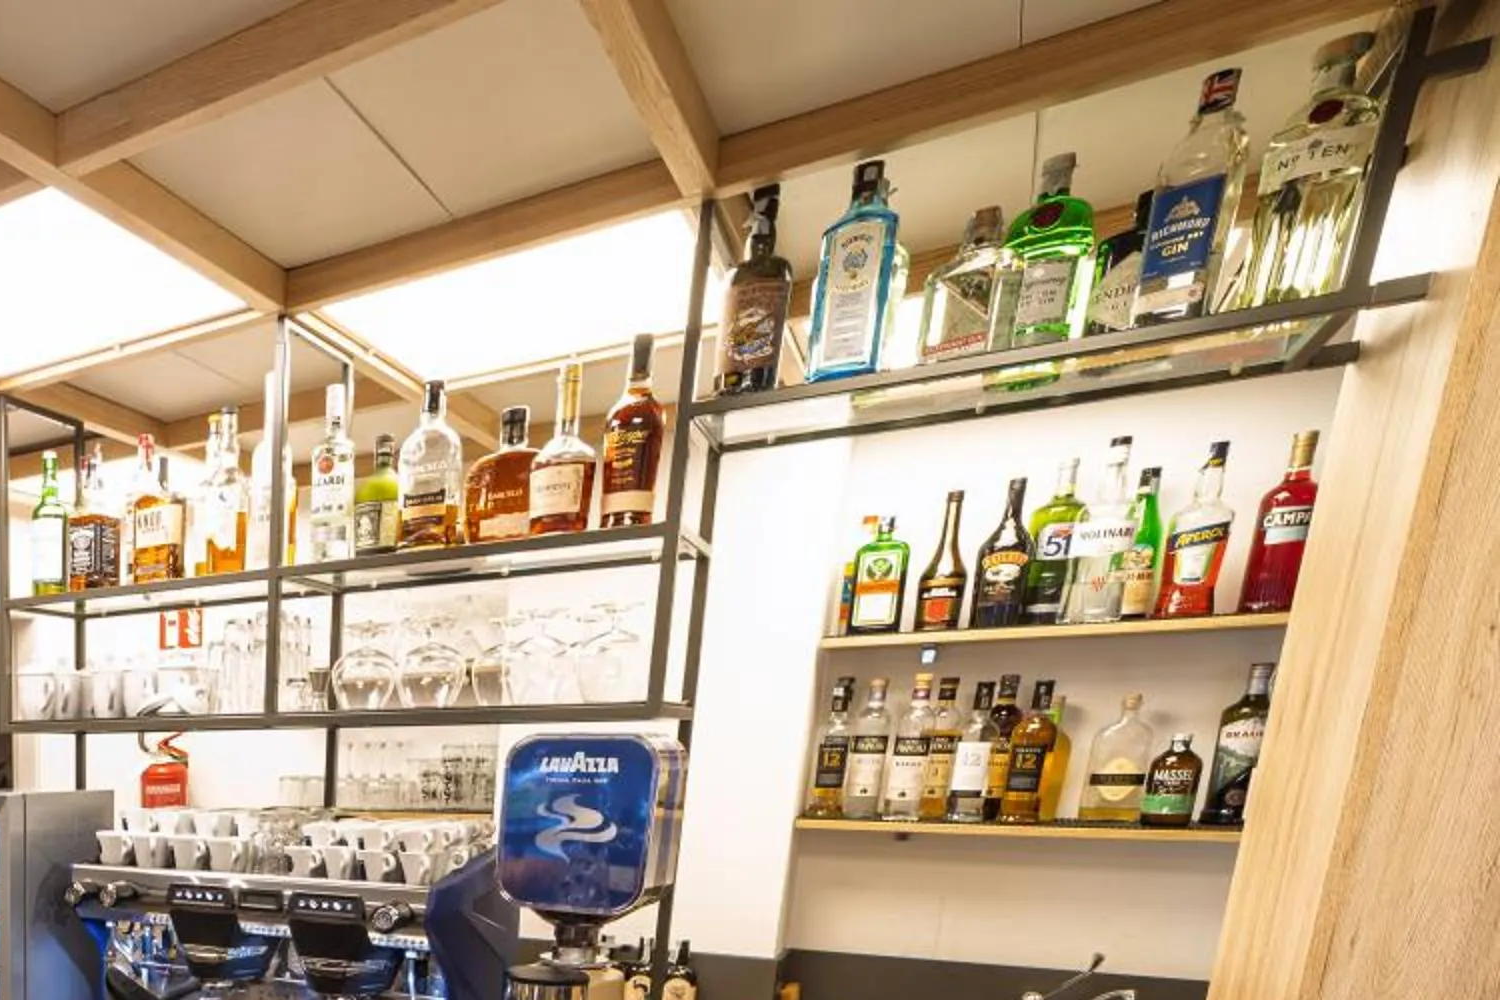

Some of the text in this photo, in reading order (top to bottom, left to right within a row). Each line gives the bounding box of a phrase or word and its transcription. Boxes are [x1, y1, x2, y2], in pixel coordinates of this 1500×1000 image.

[1151, 217, 1211, 243] RICHMOND
[1161, 241, 1190, 257] GIN
[1043, 535, 1073, 556] 51
[539, 751, 619, 773] LAVAZZA
